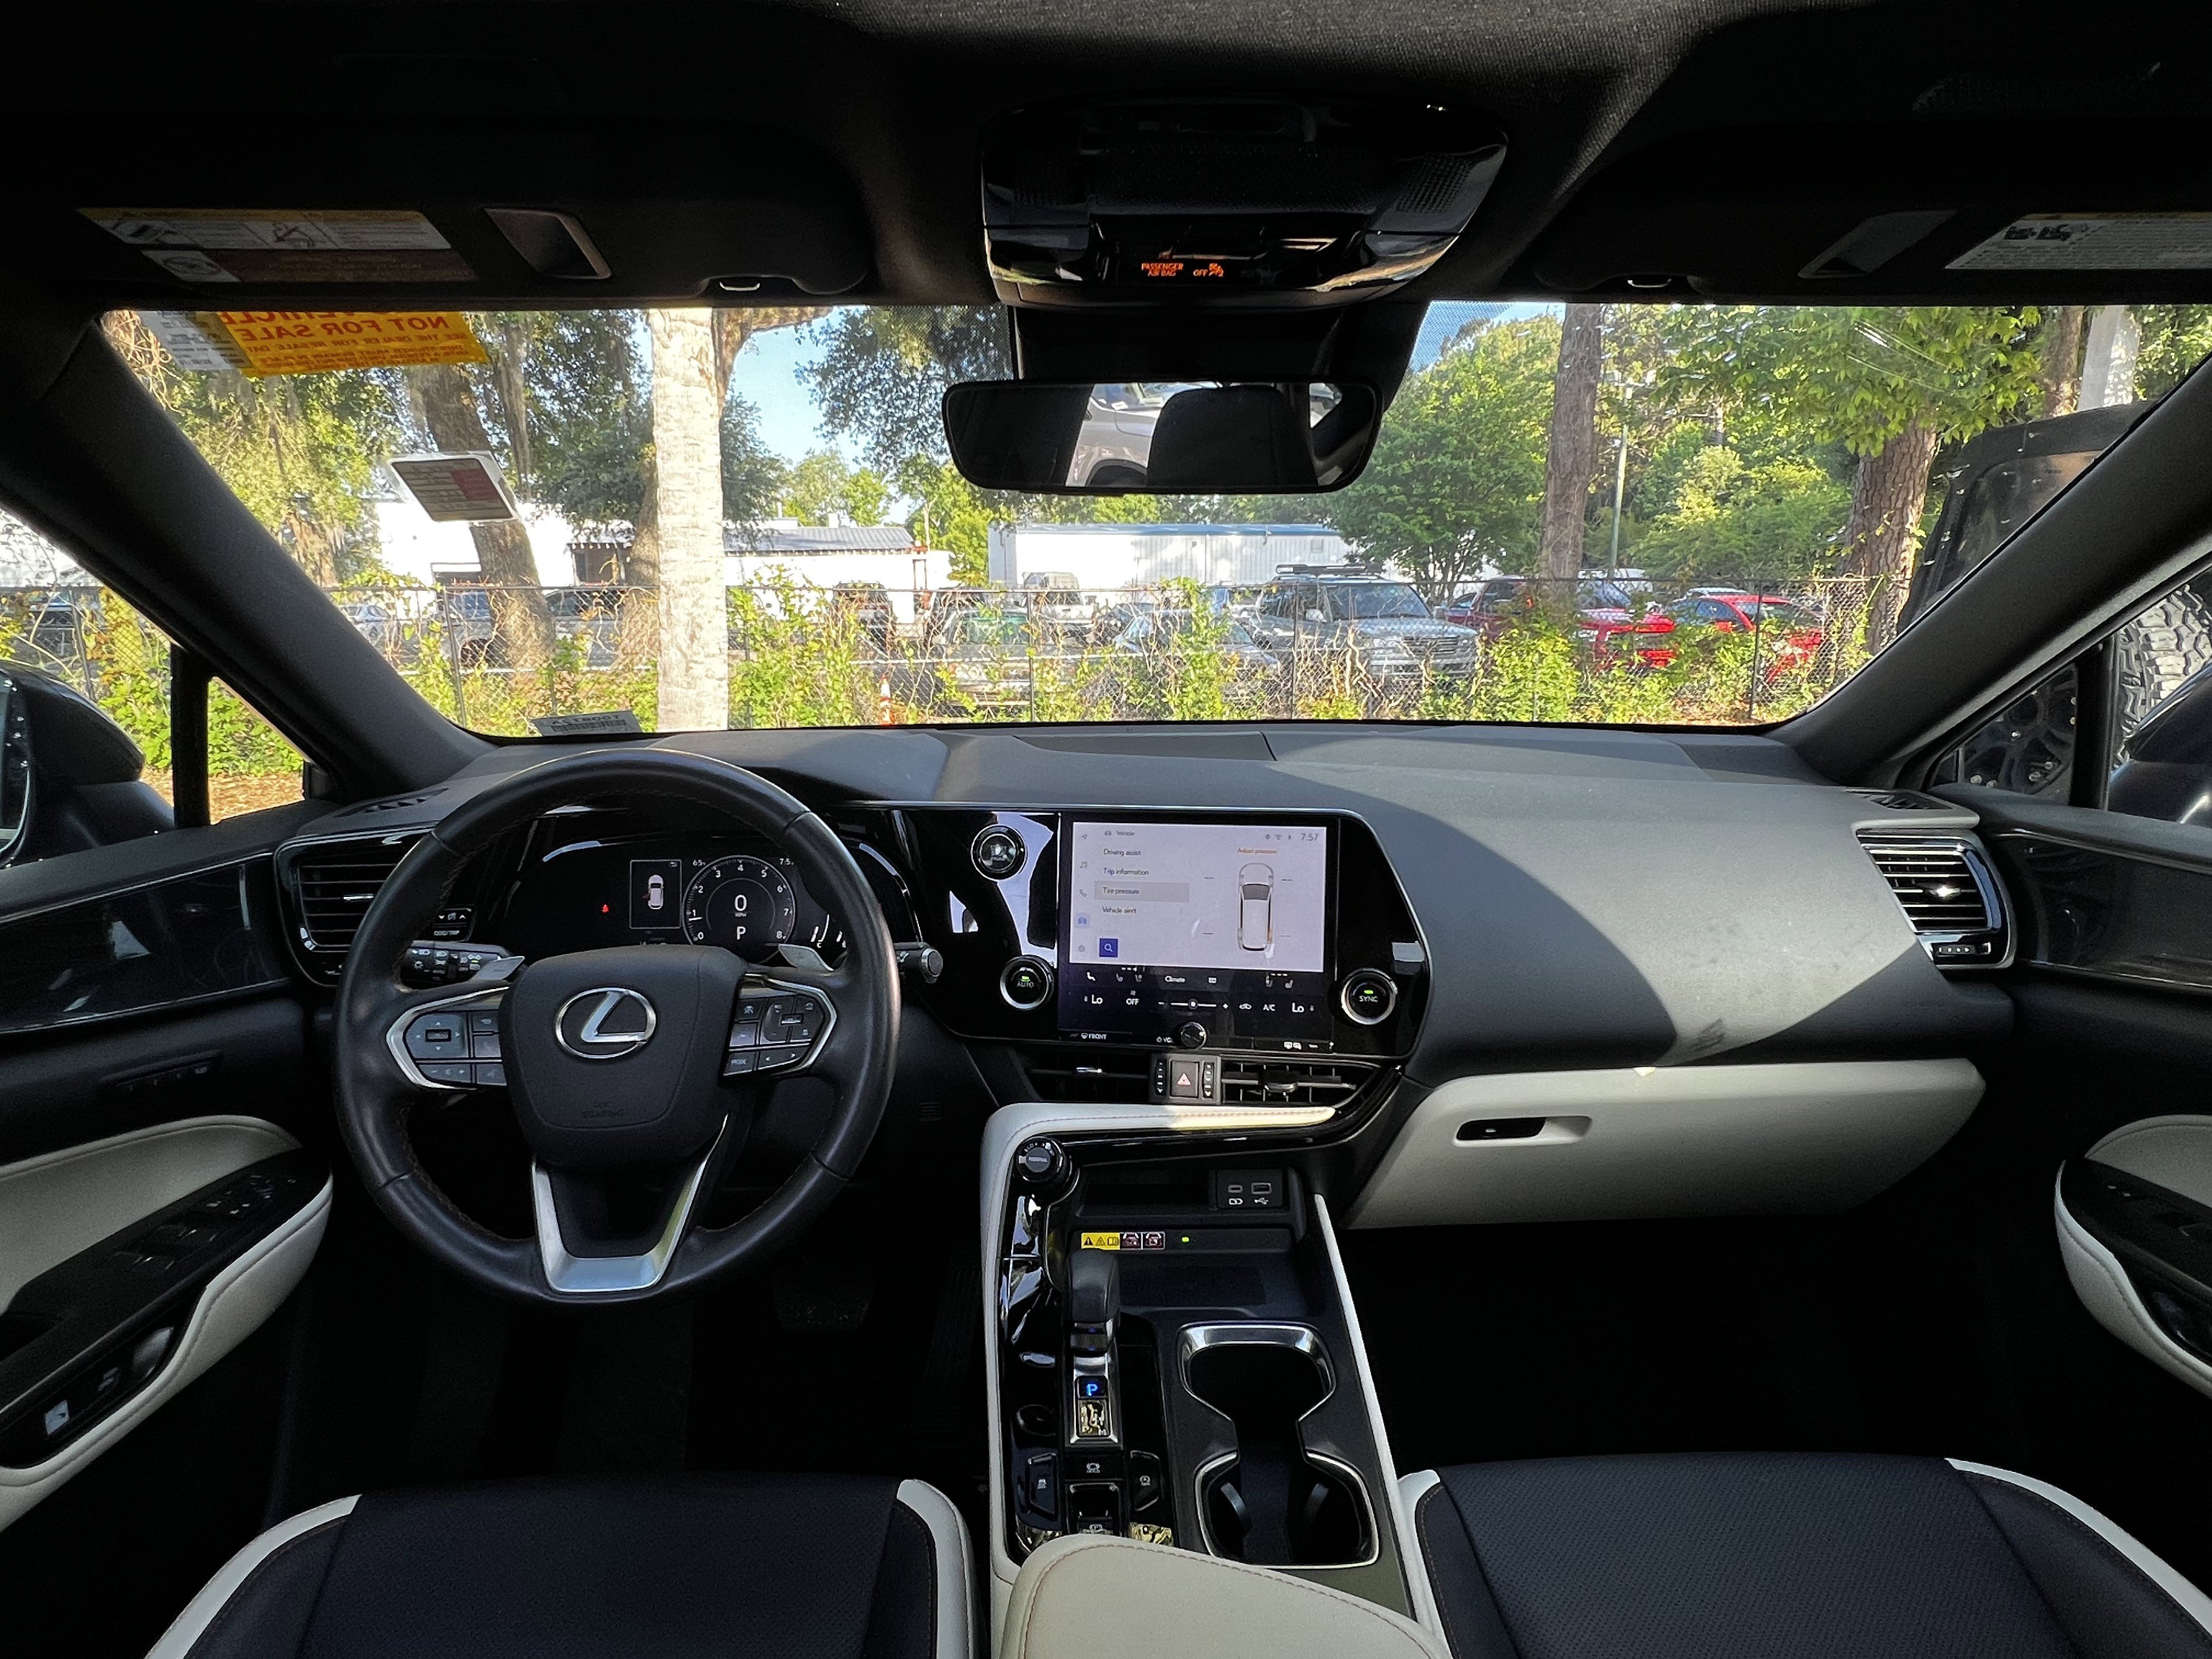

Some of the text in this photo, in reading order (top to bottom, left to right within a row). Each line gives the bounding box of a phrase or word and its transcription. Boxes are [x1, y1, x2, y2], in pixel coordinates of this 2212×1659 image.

[1301, 833, 1319, 841] 7:57
[1103, 848, 1125, 856] Driving
[1103, 867, 1115, 876] Trip
[698, 885, 704, 894] 2
[777, 885, 783, 893] 6
[734, 894, 747, 912] 0
[783, 908, 789, 916] 7
[697, 932, 704, 940] 0
[736, 926, 746, 940] P
[776, 930, 783, 939] 8
[1092, 994, 1103, 1005] Lo
[1263, 1003, 1276, 1012] A/C
[1291, 1002, 1305, 1013] Lo
[1086, 1384, 1098, 1396] P
